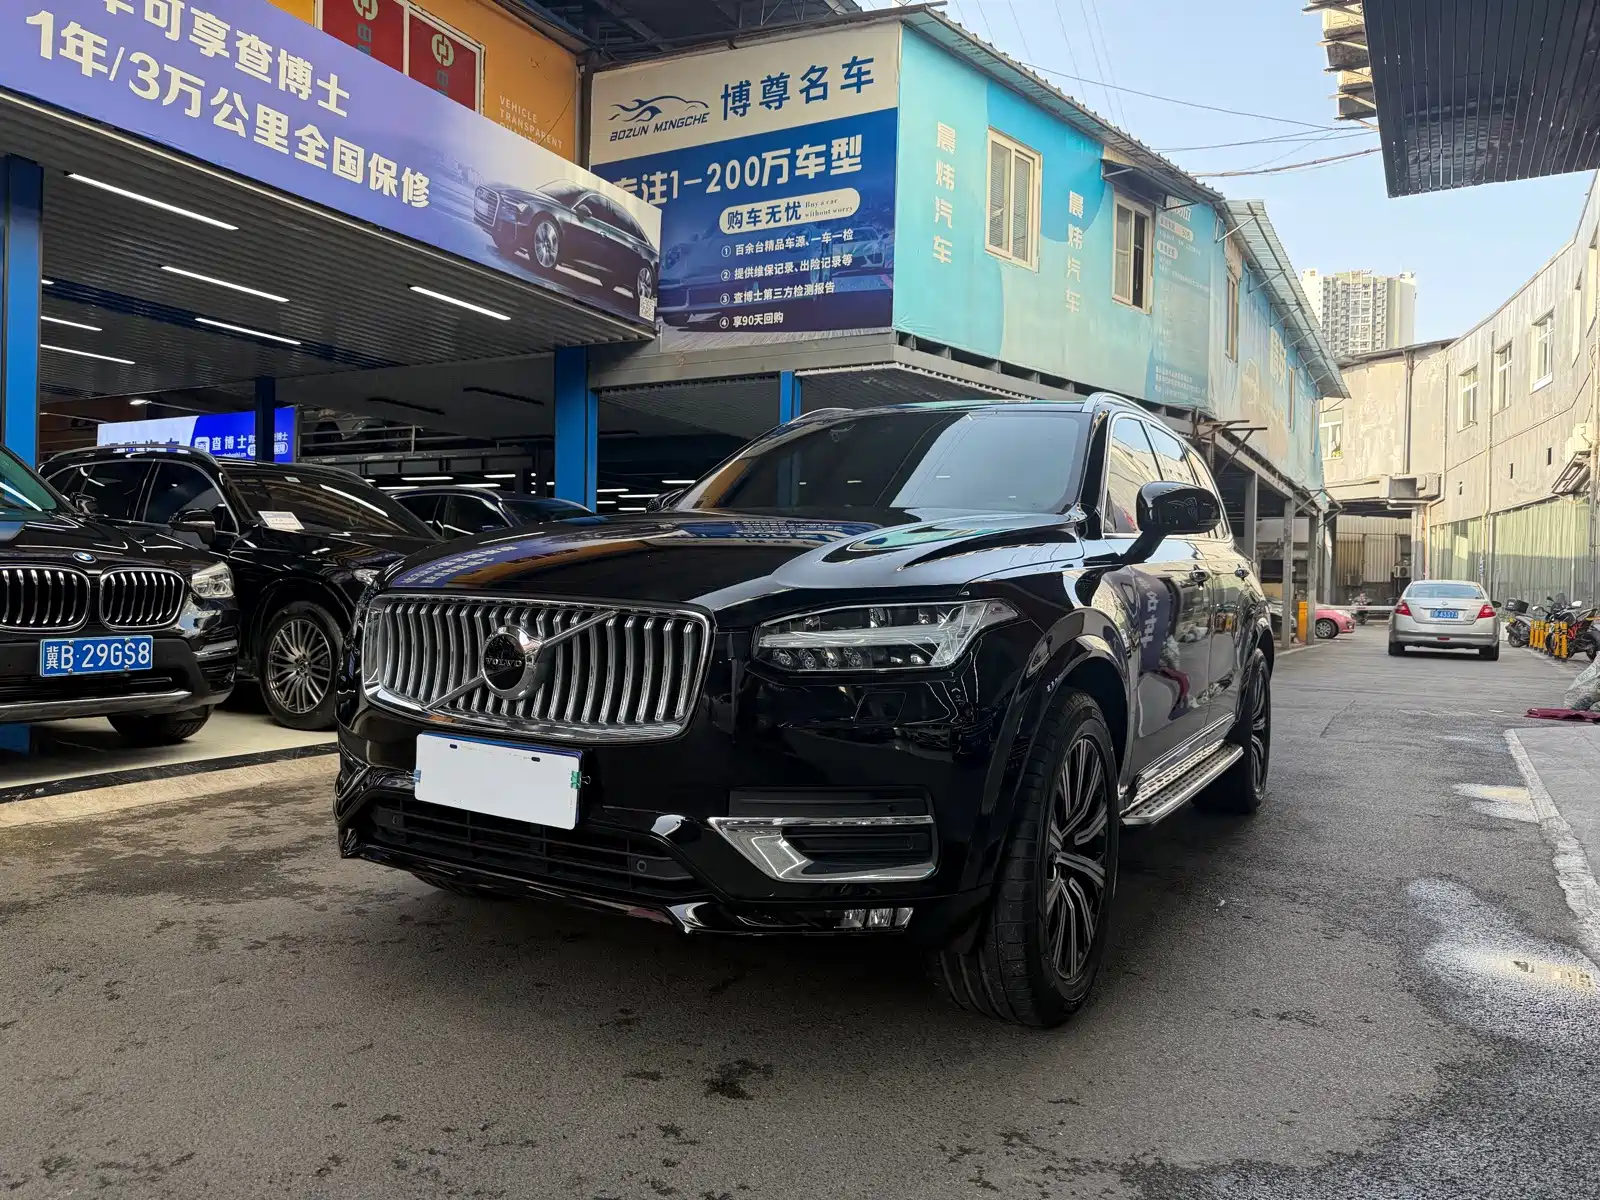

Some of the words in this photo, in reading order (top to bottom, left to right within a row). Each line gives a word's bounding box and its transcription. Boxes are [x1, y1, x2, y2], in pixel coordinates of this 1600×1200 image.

[104, 0, 350, 118] 可享查博士
[720, 55, 874, 121] 博尊名车
[26, 9, 430, 209] 1年/3万公里全国保修
[500, 95, 537, 124] VEHICLE
[499, 107, 564, 149] TRANSPARENT
[653, 112, 710, 134] MINGCHE
[727, 200, 801, 230] 购车无忧
[805, 201, 818, 209] Buy
[805, 209, 831, 218] without
[833, 206, 853, 216] worry
[733, 281, 836, 304] 查博士第三方检测报告
[733, 311, 784, 328] 享90天回购
[212, 434, 247, 451] 查博士
[485, 657, 522, 667] VOLVO
